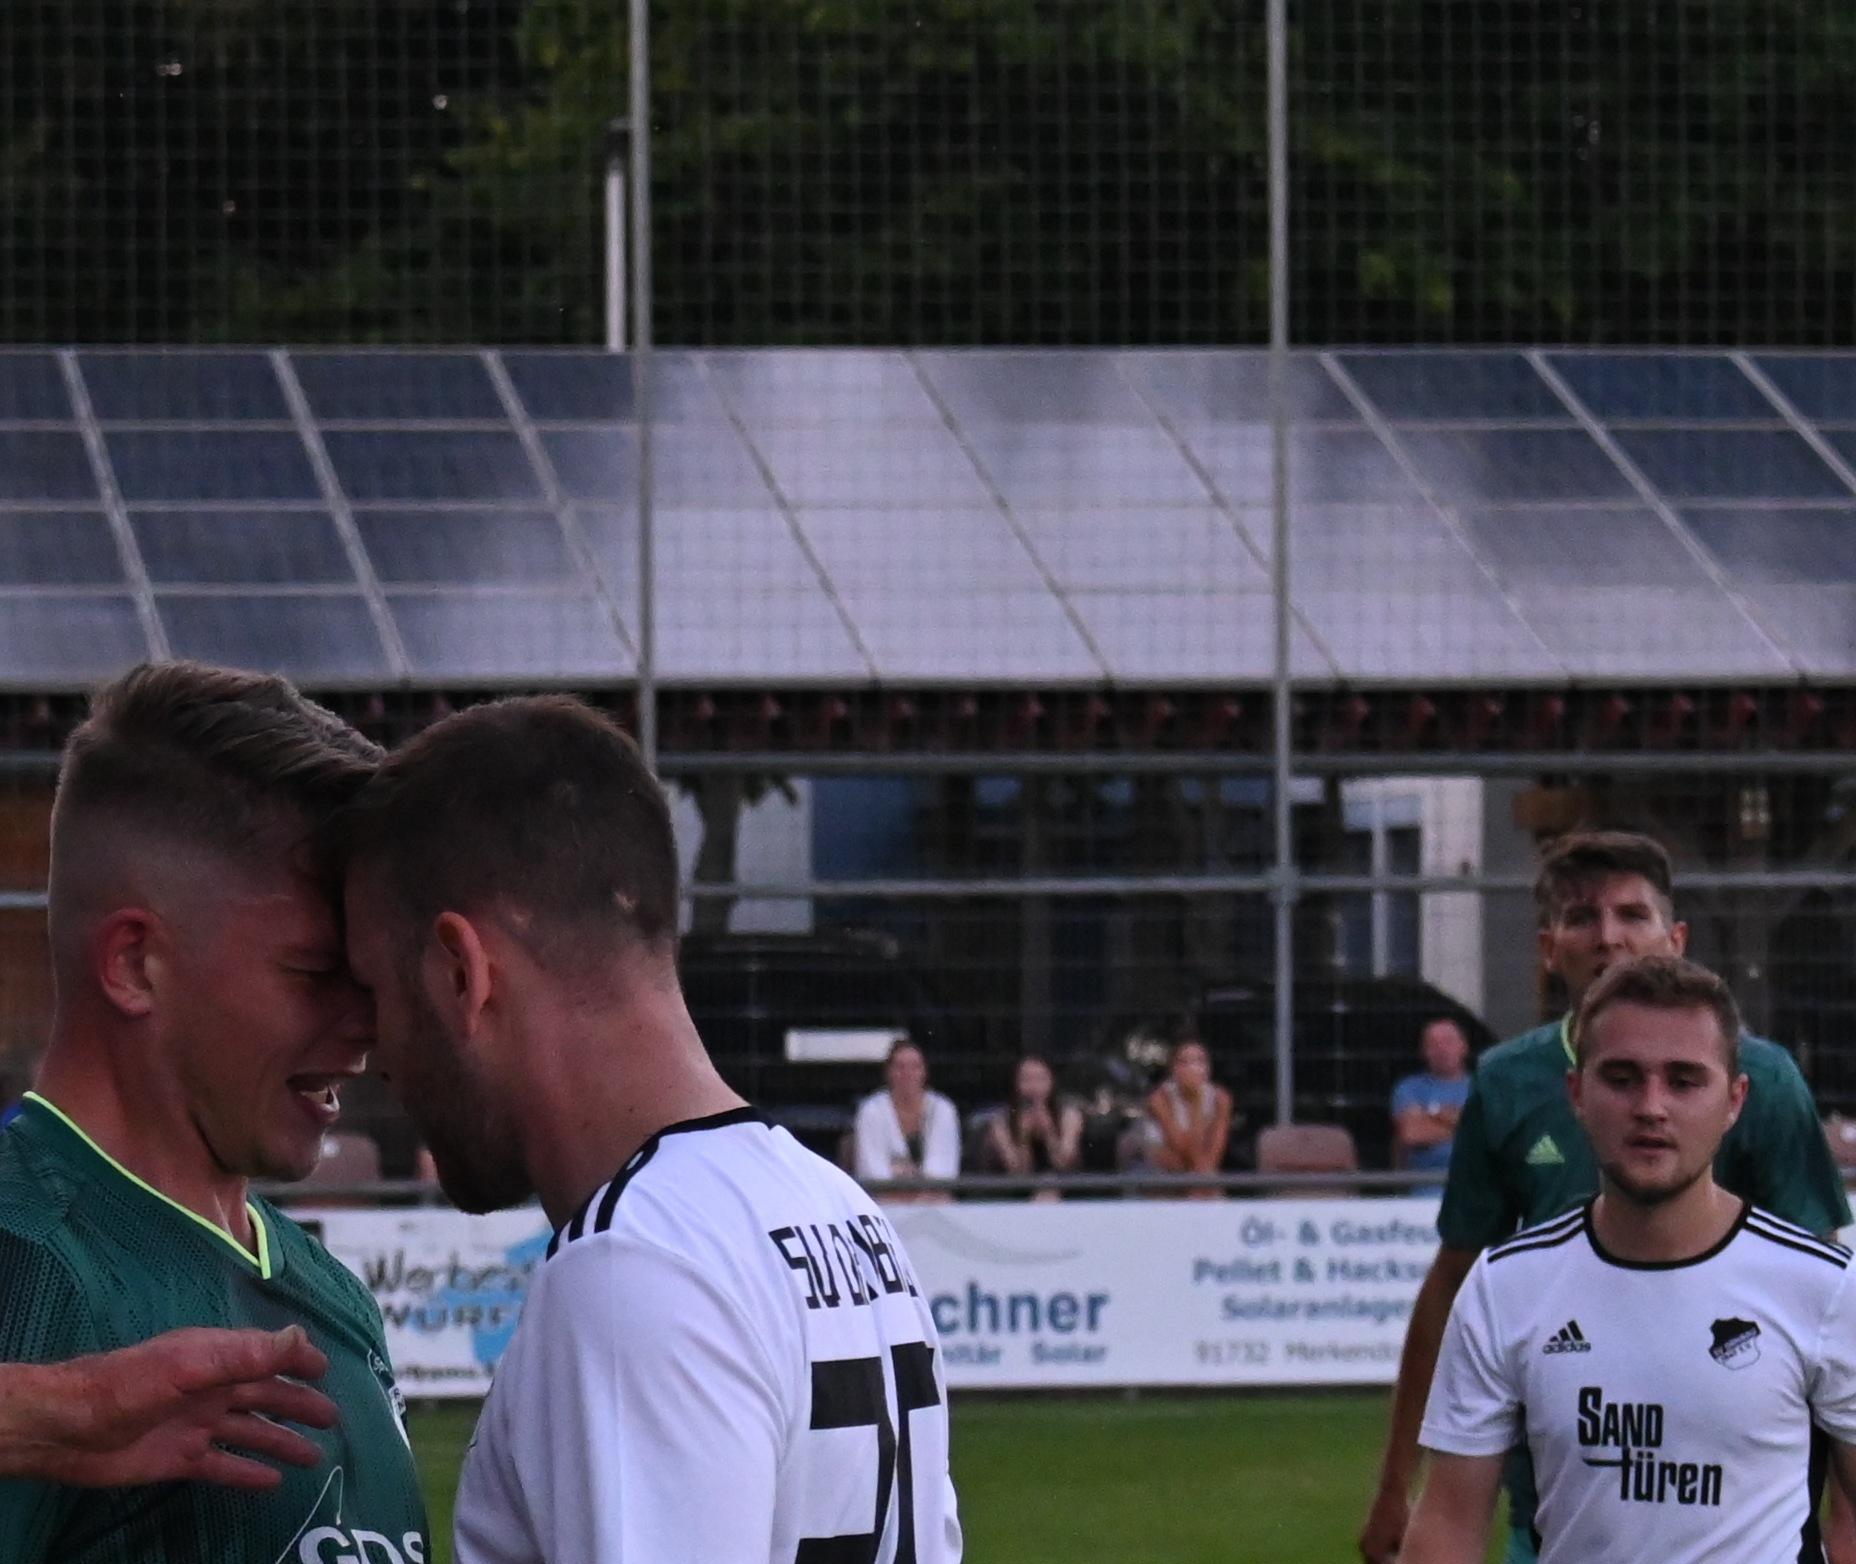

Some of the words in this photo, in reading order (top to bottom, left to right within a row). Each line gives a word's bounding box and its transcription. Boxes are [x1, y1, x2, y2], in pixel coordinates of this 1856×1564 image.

[1330, 1214, 1442, 1245] Gasfeu
[1325, 1256, 1428, 1285] Hacks
[931, 1281, 1111, 1334] chner
[1221, 1295, 1413, 1325] Solaranlage
[1582, 1448, 1723, 1506] türen
